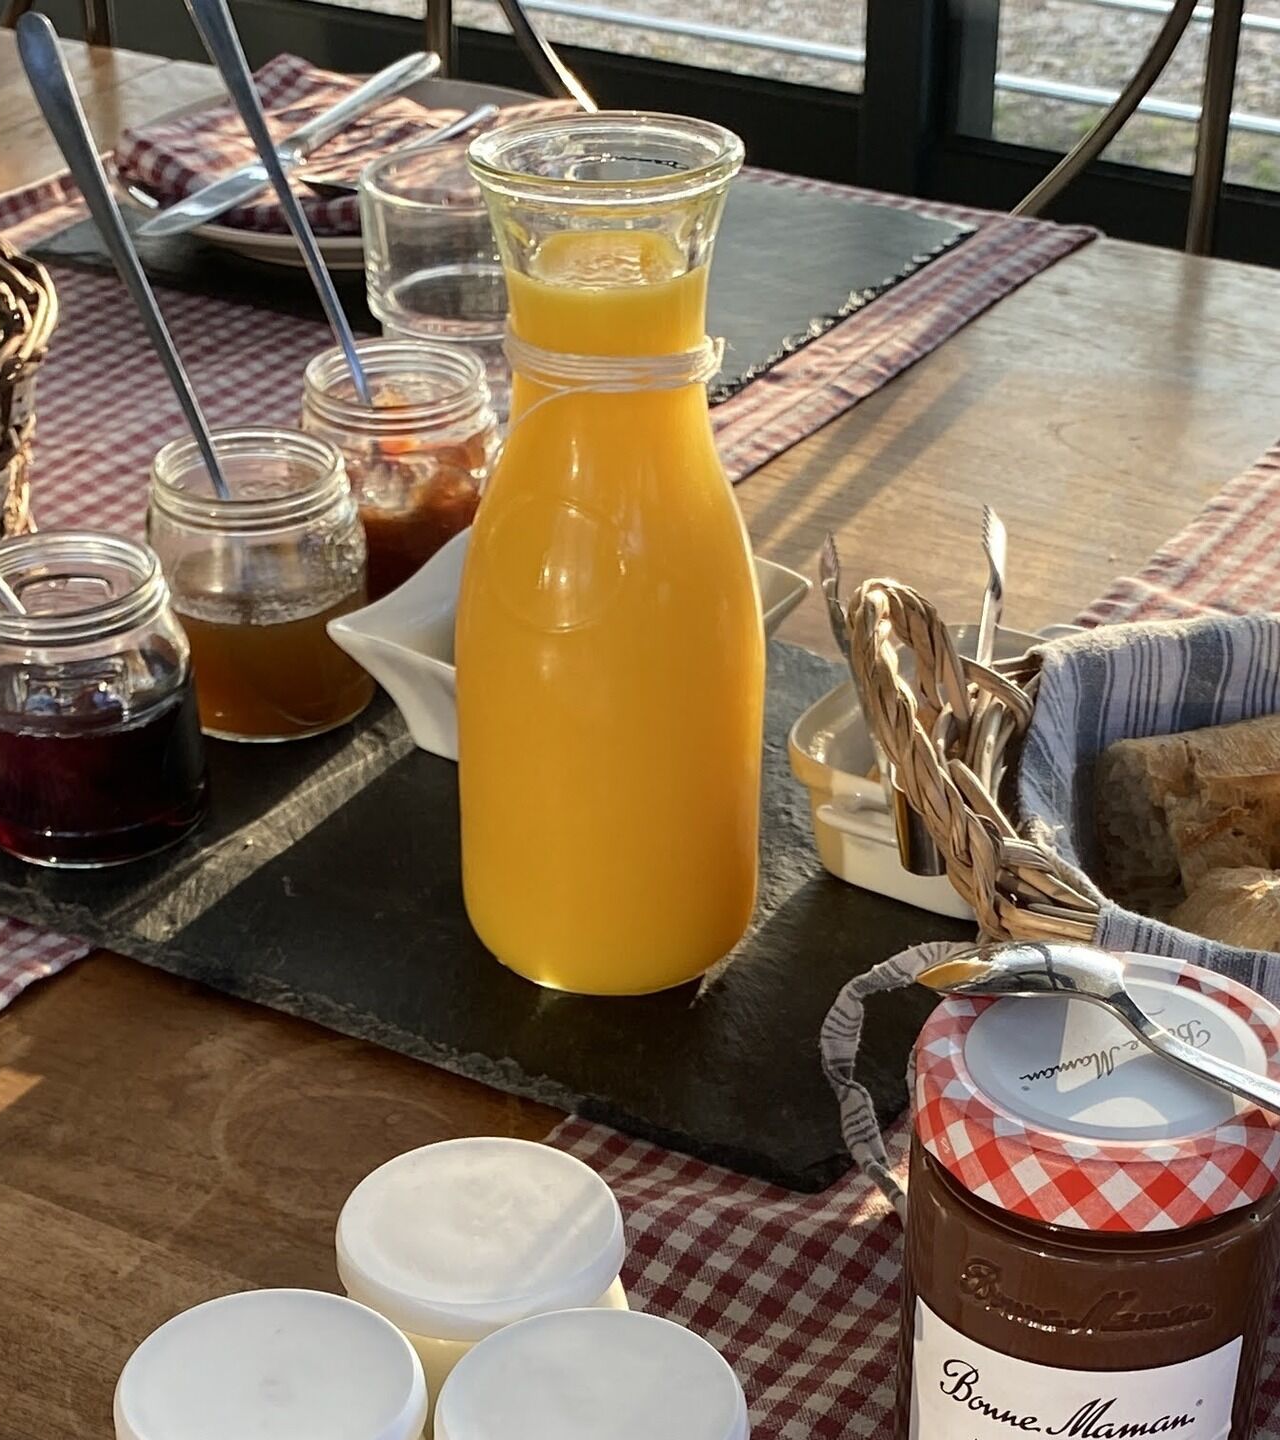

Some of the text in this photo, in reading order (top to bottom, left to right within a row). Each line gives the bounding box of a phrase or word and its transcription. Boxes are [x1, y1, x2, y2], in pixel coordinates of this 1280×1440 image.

[1019, 1046, 1120, 1081] Maman
[939, 1359, 1196, 1439] Bonne Maman
